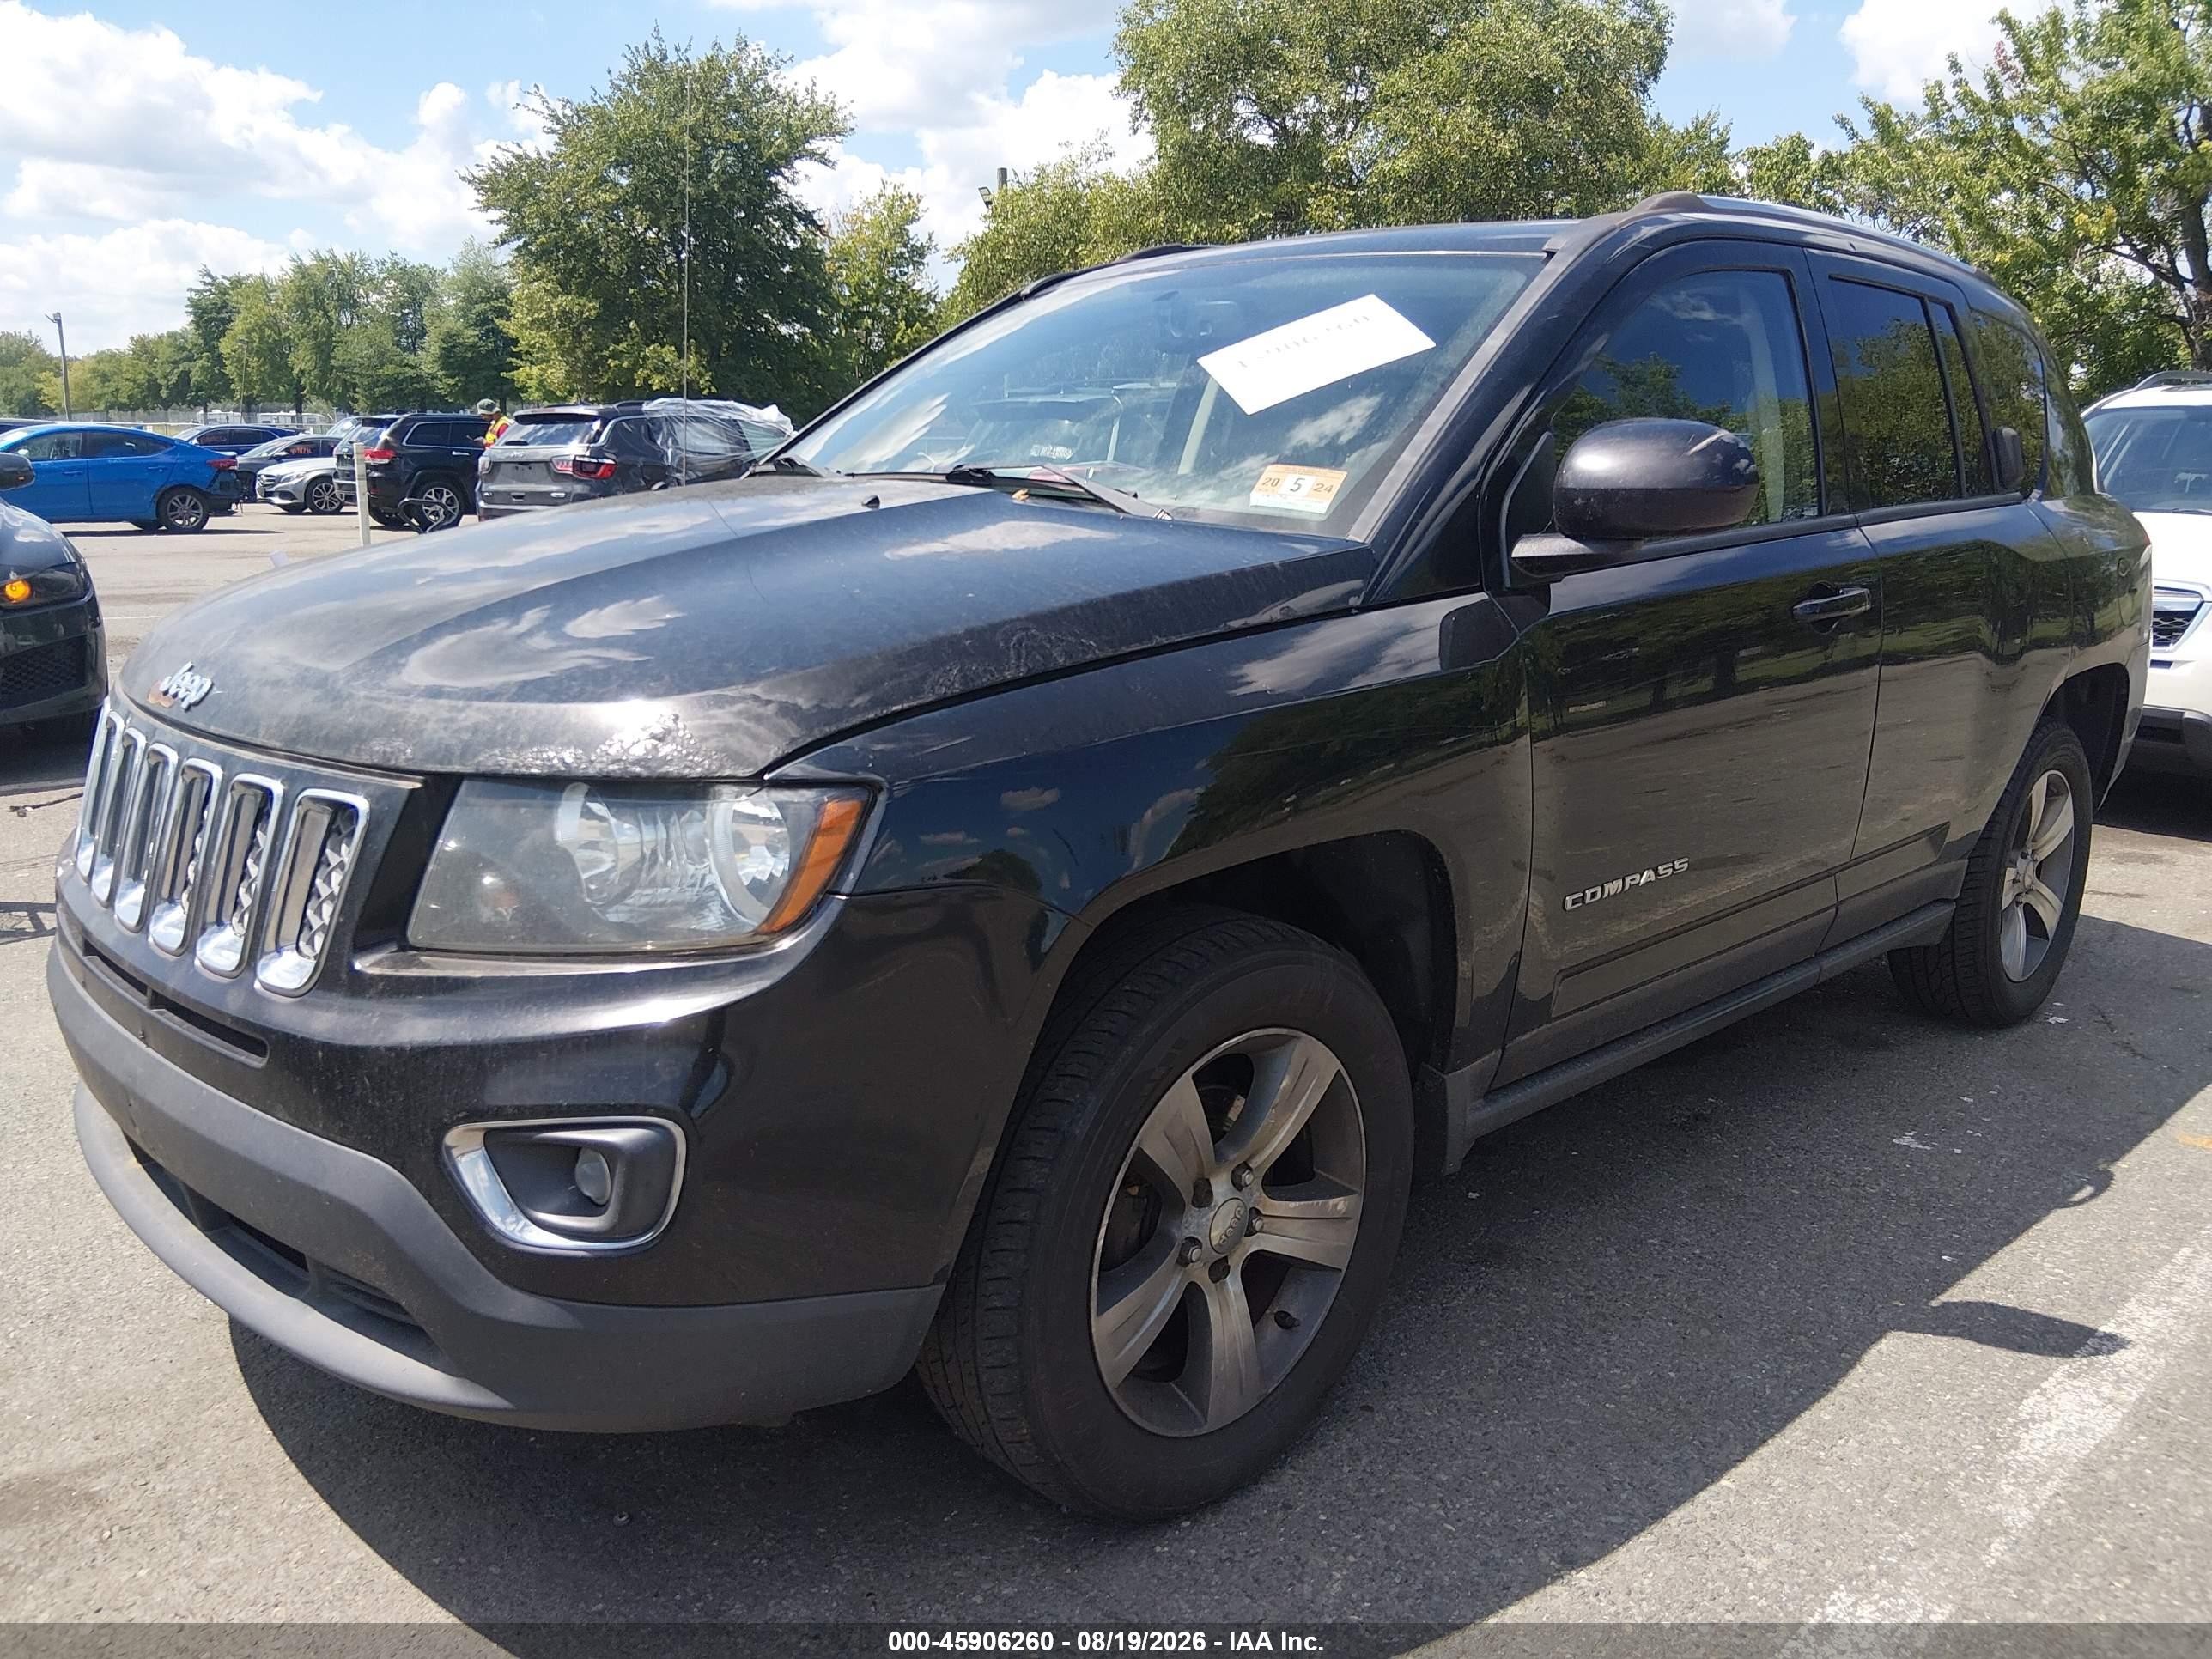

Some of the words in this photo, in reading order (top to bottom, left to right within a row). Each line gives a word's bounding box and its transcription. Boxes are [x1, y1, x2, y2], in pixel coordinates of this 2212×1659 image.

[1262, 477, 1281, 488] 20
[1290, 477, 1306, 493] 5
[1313, 483, 1334, 494] 24
[159, 660, 214, 712] Jeep
[1565, 856, 1690, 912] COMPASS
